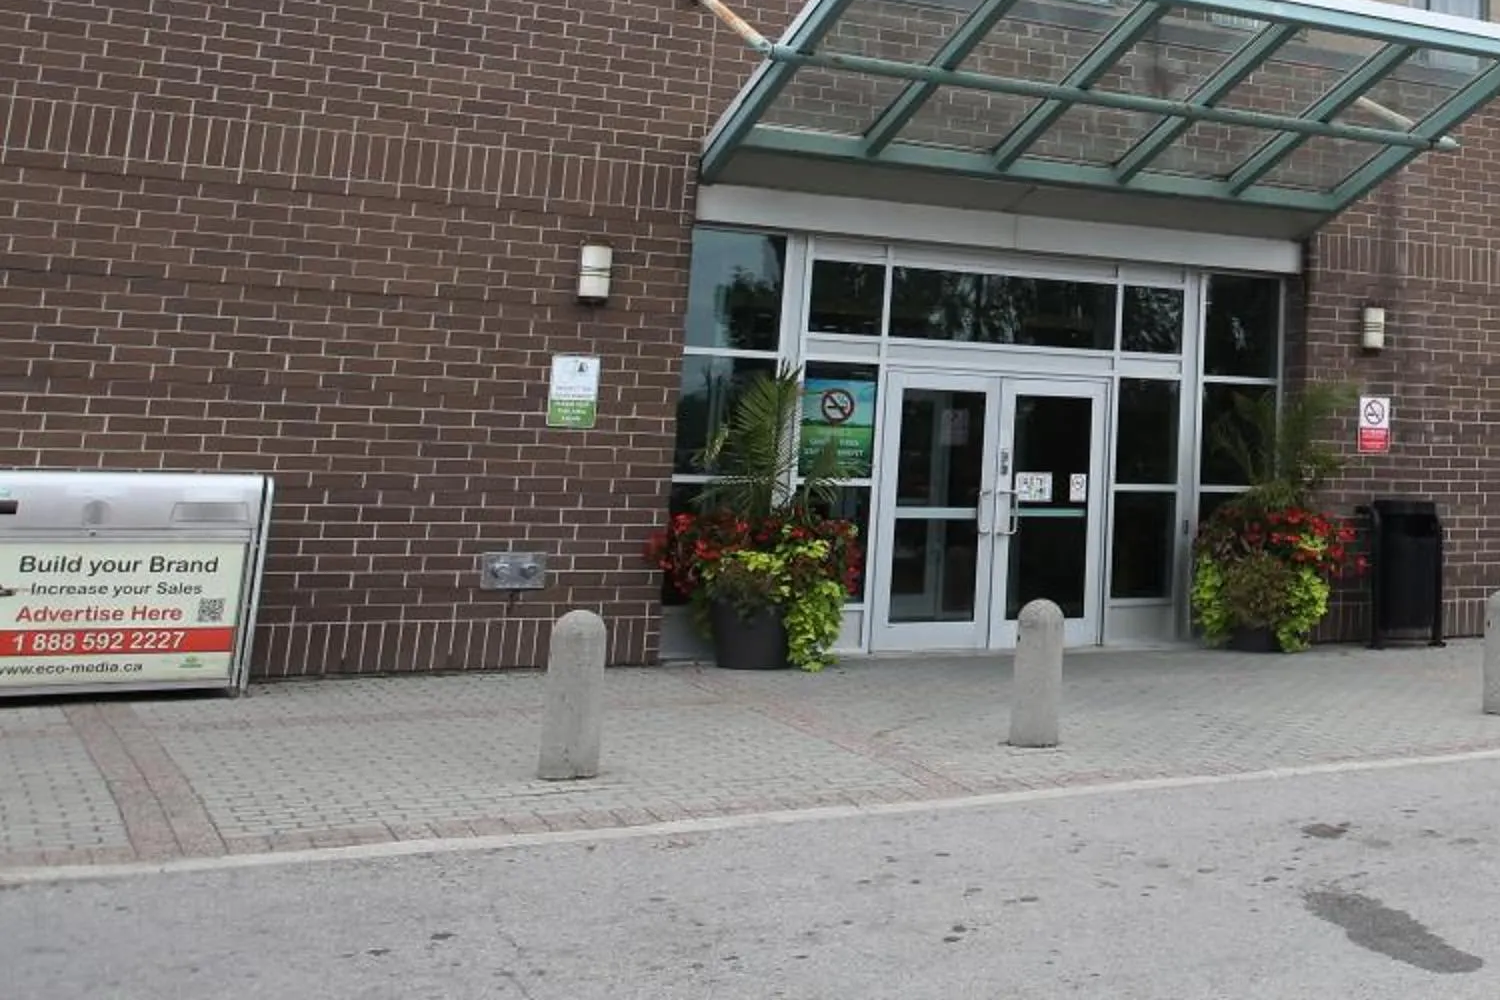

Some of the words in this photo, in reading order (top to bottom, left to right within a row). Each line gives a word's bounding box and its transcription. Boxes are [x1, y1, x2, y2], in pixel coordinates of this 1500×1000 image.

[19, 555, 83, 573] Build
[87, 559, 142, 577] your
[149, 555, 219, 573] Brand
[31, 582, 108, 596] Increase
[112, 584, 151, 599] your
[157, 581, 203, 595] Sales
[15, 605, 124, 622] Advertise
[131, 605, 182, 621] Here
[12, 633, 24, 652] 1
[33, 632, 76, 651] 888
[82, 631, 124, 651] 592
[130, 630, 185, 649] 2227
